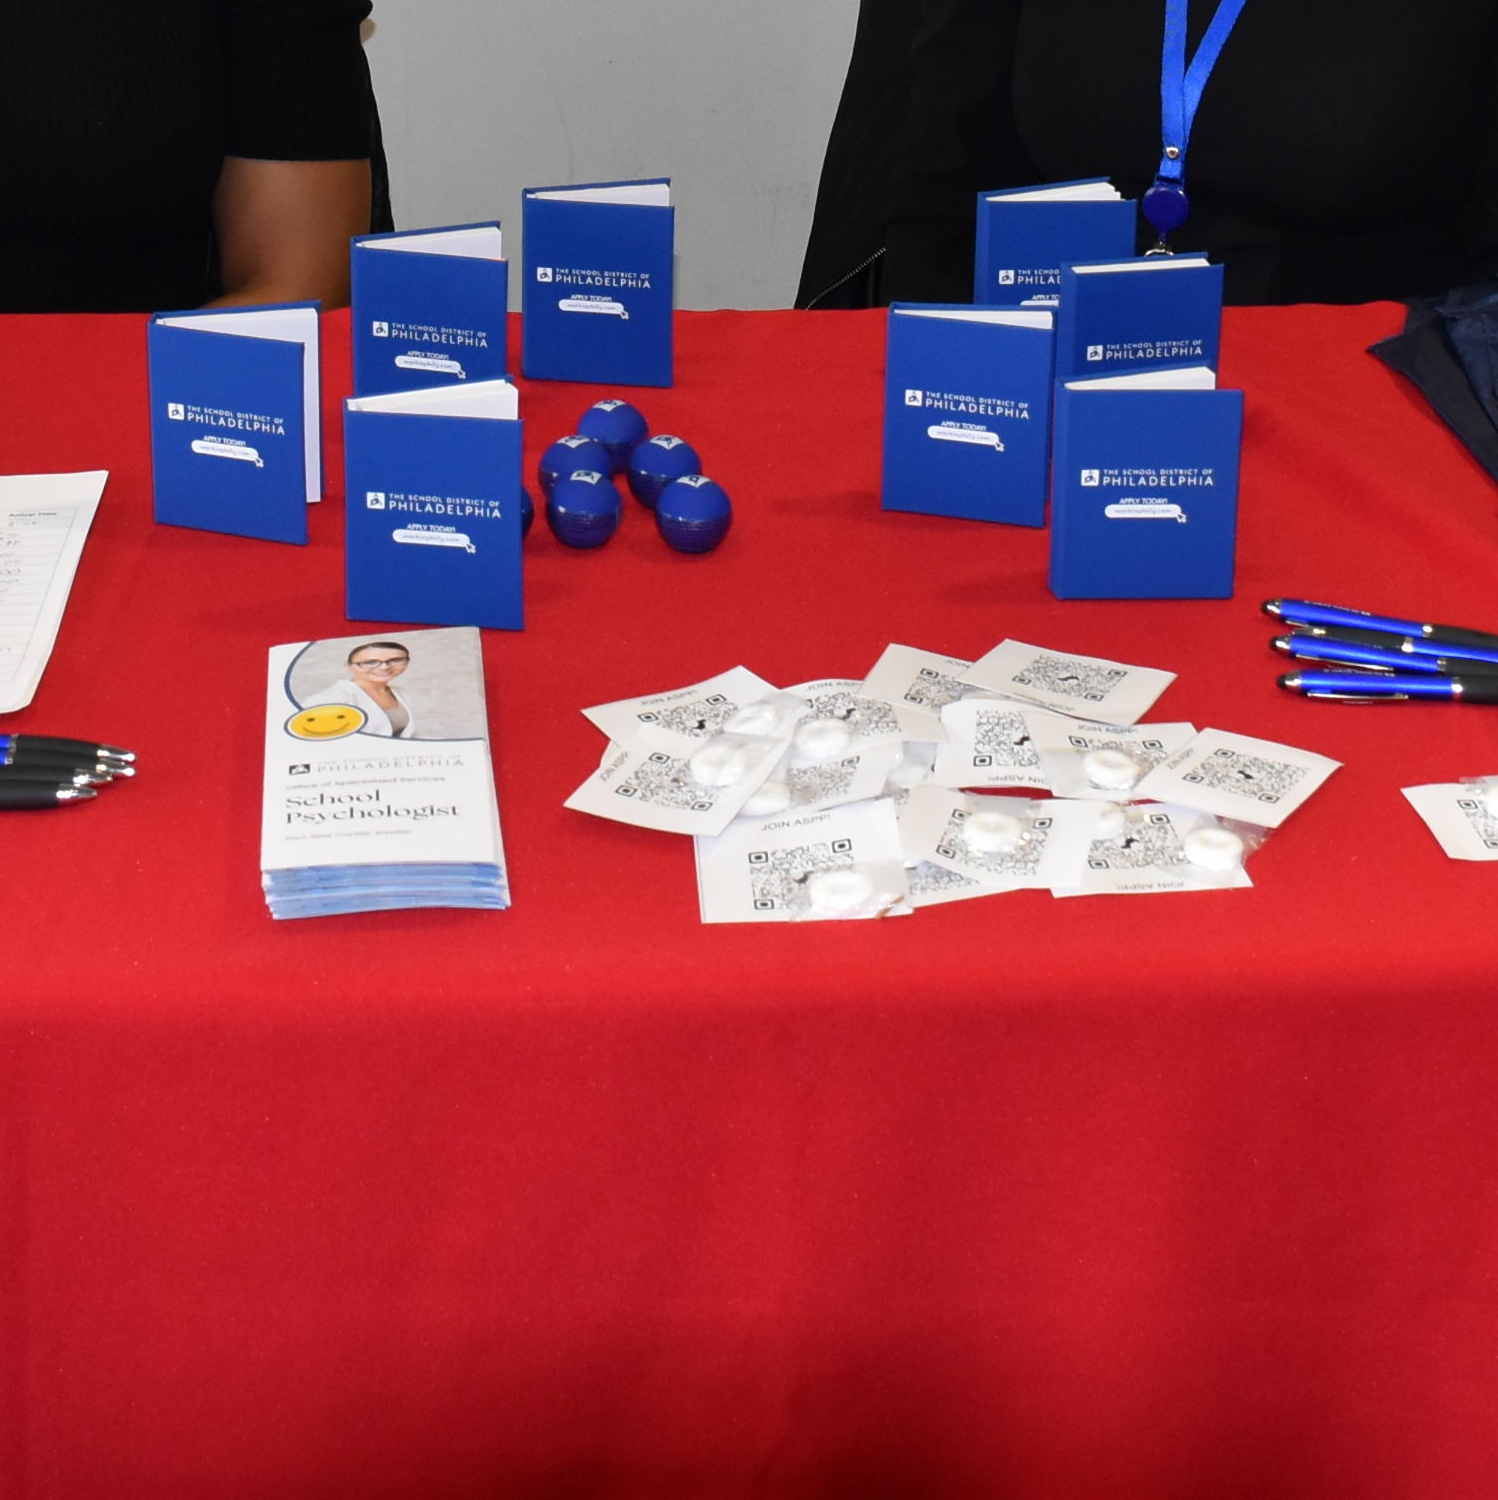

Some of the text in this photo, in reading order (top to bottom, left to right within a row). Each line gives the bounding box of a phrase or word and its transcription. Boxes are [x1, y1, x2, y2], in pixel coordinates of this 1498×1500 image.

[604, 271, 636, 279] DISTRICT
[555, 275, 651, 289] PHILADELPHIA
[408, 324, 437, 333] SCHOOL
[441, 327, 474, 337] DISTRICT
[392, 330, 488, 348] PHILADELPHIA
[1123, 342, 1152, 350] SCHOOL
[1156, 340, 1189, 348] DISTRICT
[407, 350, 425, 358] APPLY
[1106, 346, 1202, 360] PHILADELPHIA
[926, 391, 940, 399] THE
[943, 394, 975, 403] SCHOOL
[978, 397, 1015, 407] DISTRICT
[188, 405, 201, 413] THE
[204, 407, 234, 418] SCHOOL
[237, 412, 270, 423] DISTRICT
[925, 398, 1029, 420] PHILADELPHIA
[188, 412, 285, 436] PHILADELPHIA
[941, 421, 961, 429] APPLY
[203, 435, 221, 444] APPLY
[1103, 476, 1214, 486] PHILADELPHIA
[408, 494, 443, 503] SCHOOL
[447, 497, 485, 507] DISTRICT
[488, 500, 500, 508] OF
[1119, 497, 1140, 505] APPLY
[389, 500, 501, 519] PHILADELPHIA
[407, 523, 428, 531] APPLY
[806, 682, 832, 691] JOIN
[641, 698, 664, 706] JOIN
[317, 759, 464, 772] PHILADELPHIA
[286, 789, 380, 808] School
[286, 804, 459, 824] Psychologist
[761, 813, 830, 832] JOIN ASPP!
